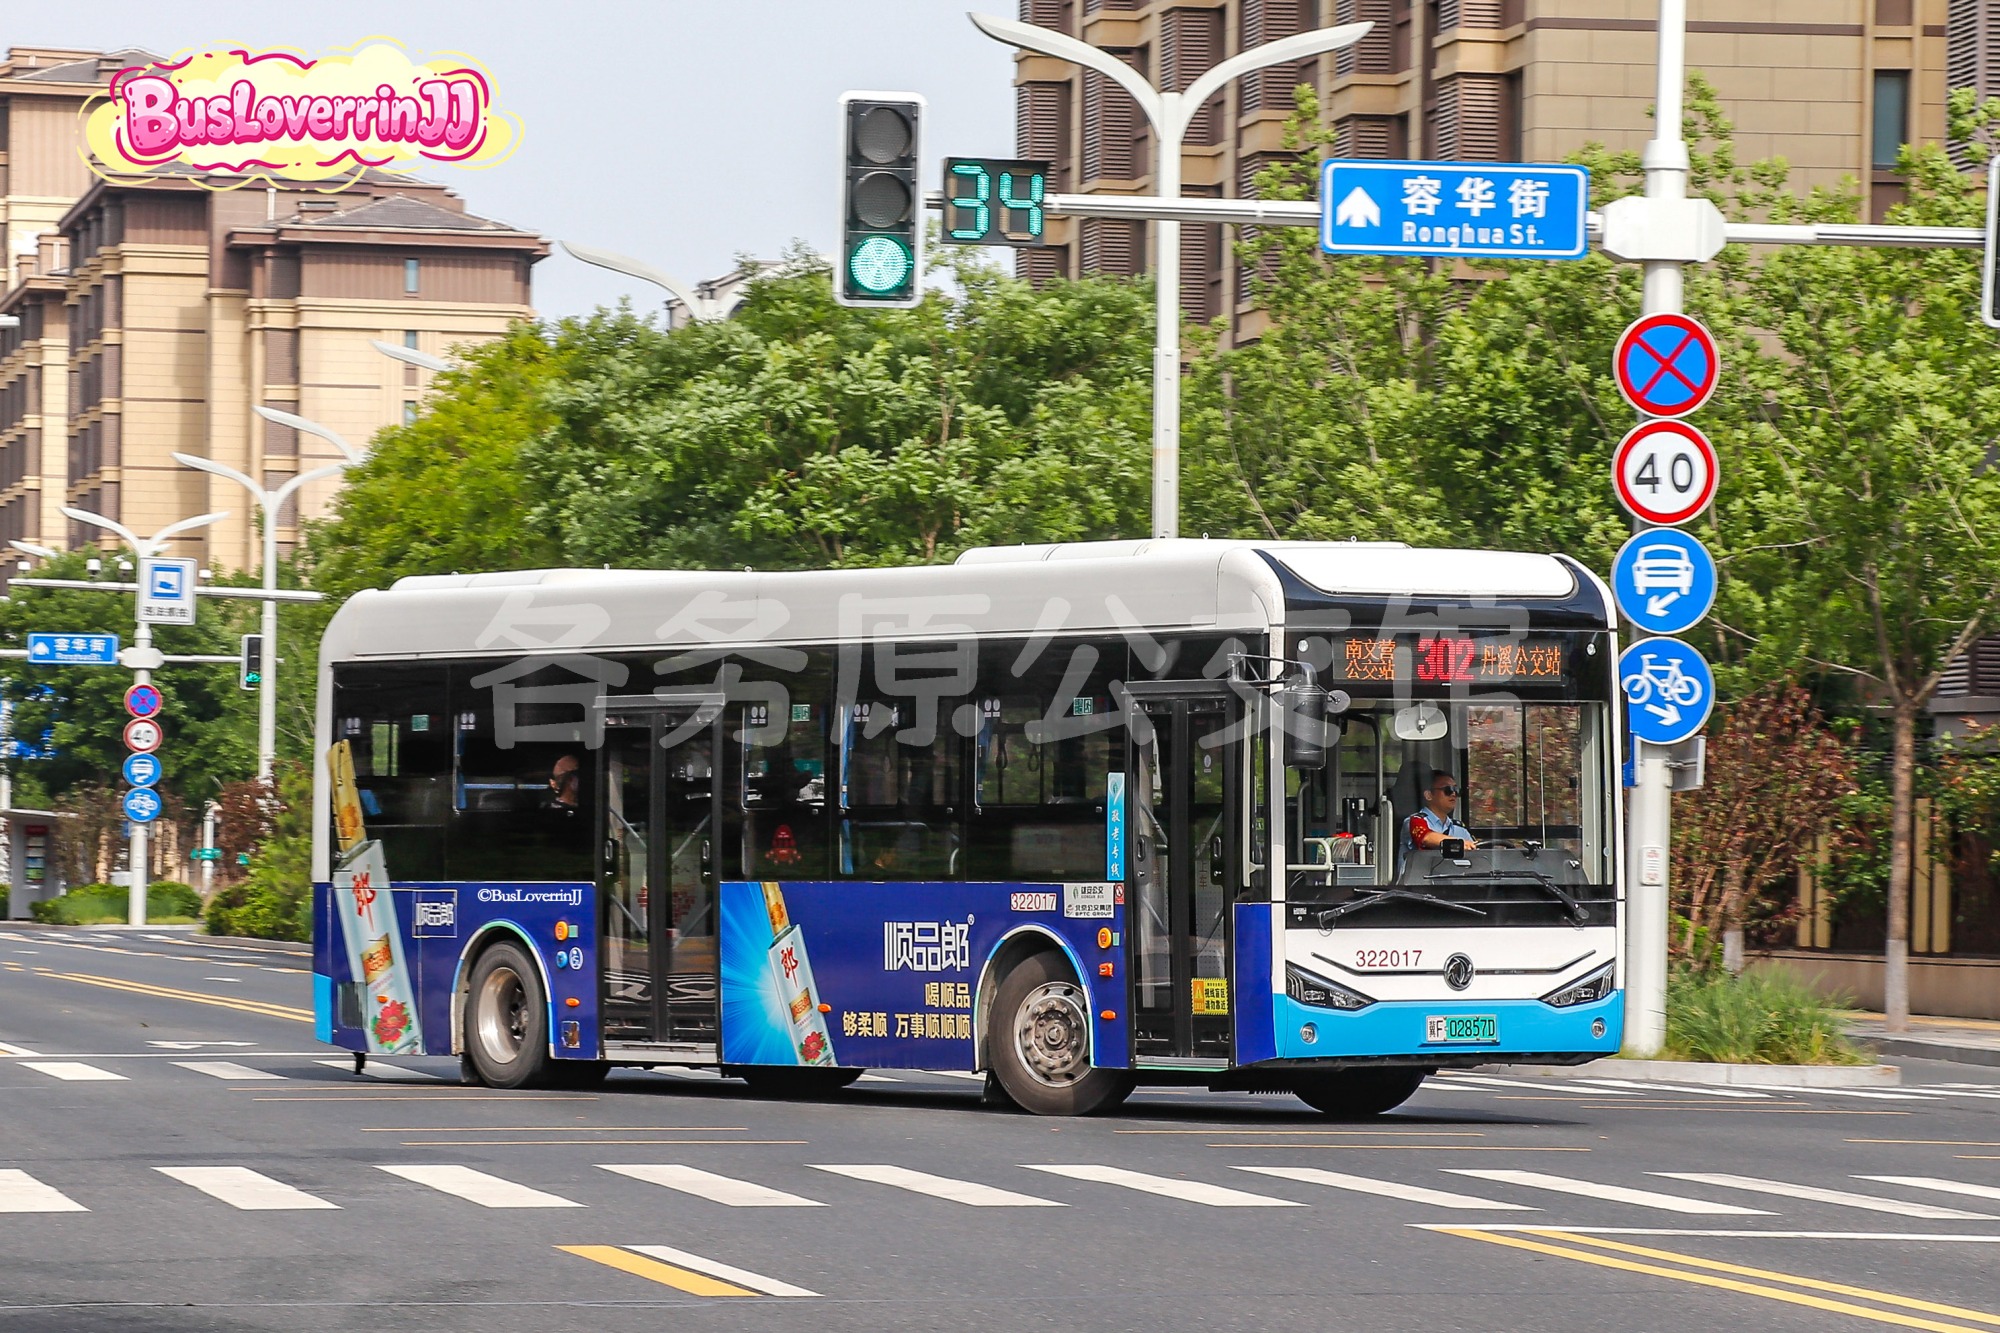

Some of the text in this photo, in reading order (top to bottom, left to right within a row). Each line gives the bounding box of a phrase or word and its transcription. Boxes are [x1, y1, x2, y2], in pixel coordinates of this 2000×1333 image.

[951, 164, 1045, 239] 34
[1401, 175, 1550, 218] 容华街
[1401, 221, 1545, 248] Ronghua St.
[1632, 452, 1693, 494] 40
[1344, 659, 1396, 680] 公交站
[1416, 638, 1476, 681] 302
[1480, 644, 1561, 676] 丹溪公交站
[131, 729, 155, 743] 40
[1011, 893, 1056, 910] 322017
[884, 920, 970, 971] 顺品郎
[1356, 950, 1422, 967] 322017
[925, 982, 971, 1008] 喝顺品
[842, 1011, 888, 1037] 够柔顺
[895, 1013, 971, 1039] 万事顺顺顺
